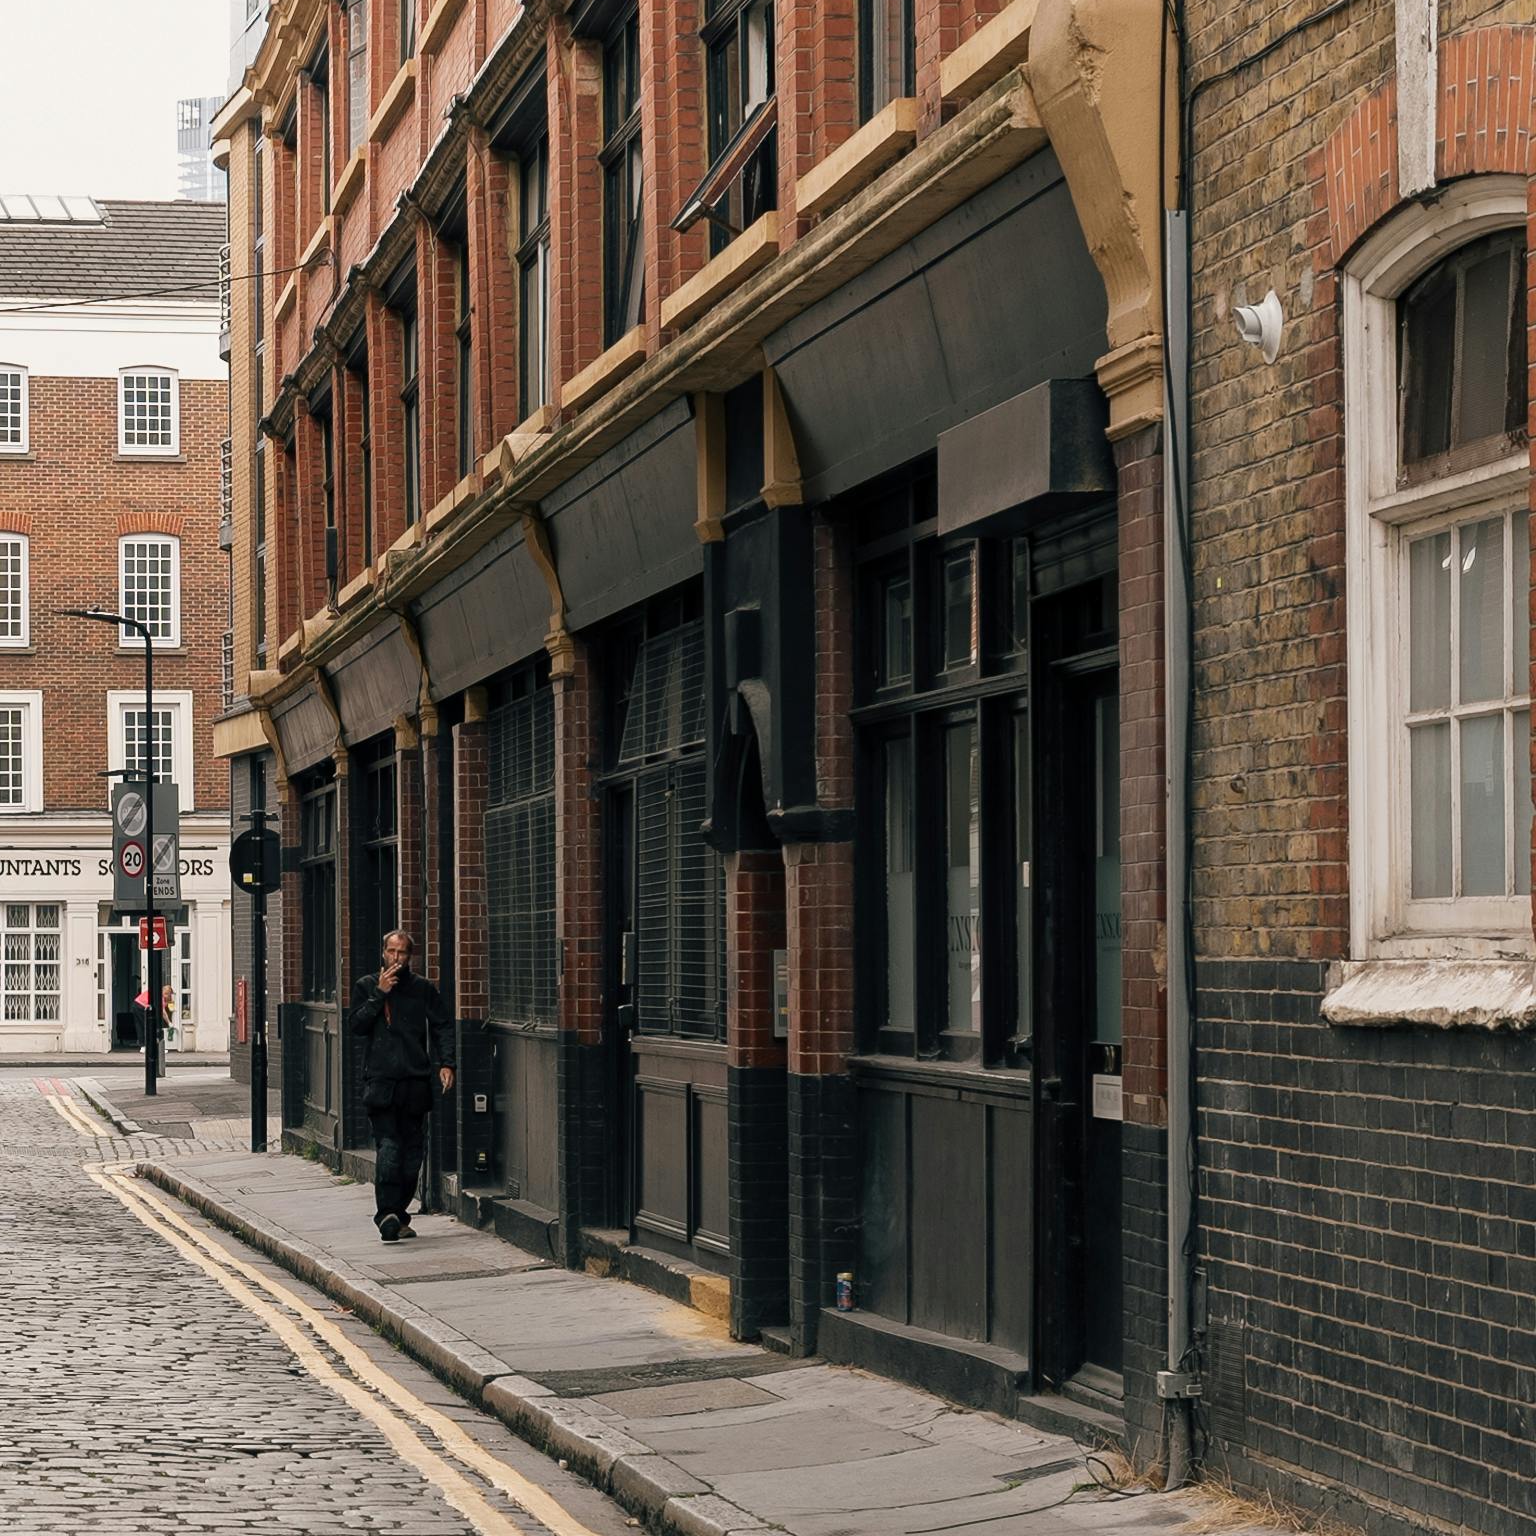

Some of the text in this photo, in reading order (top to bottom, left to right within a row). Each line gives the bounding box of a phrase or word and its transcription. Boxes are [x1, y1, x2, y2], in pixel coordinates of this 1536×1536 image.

[124, 852, 141, 867] 20
[155, 877, 170, 885] Zone
[153, 886, 175, 896] ENDS
